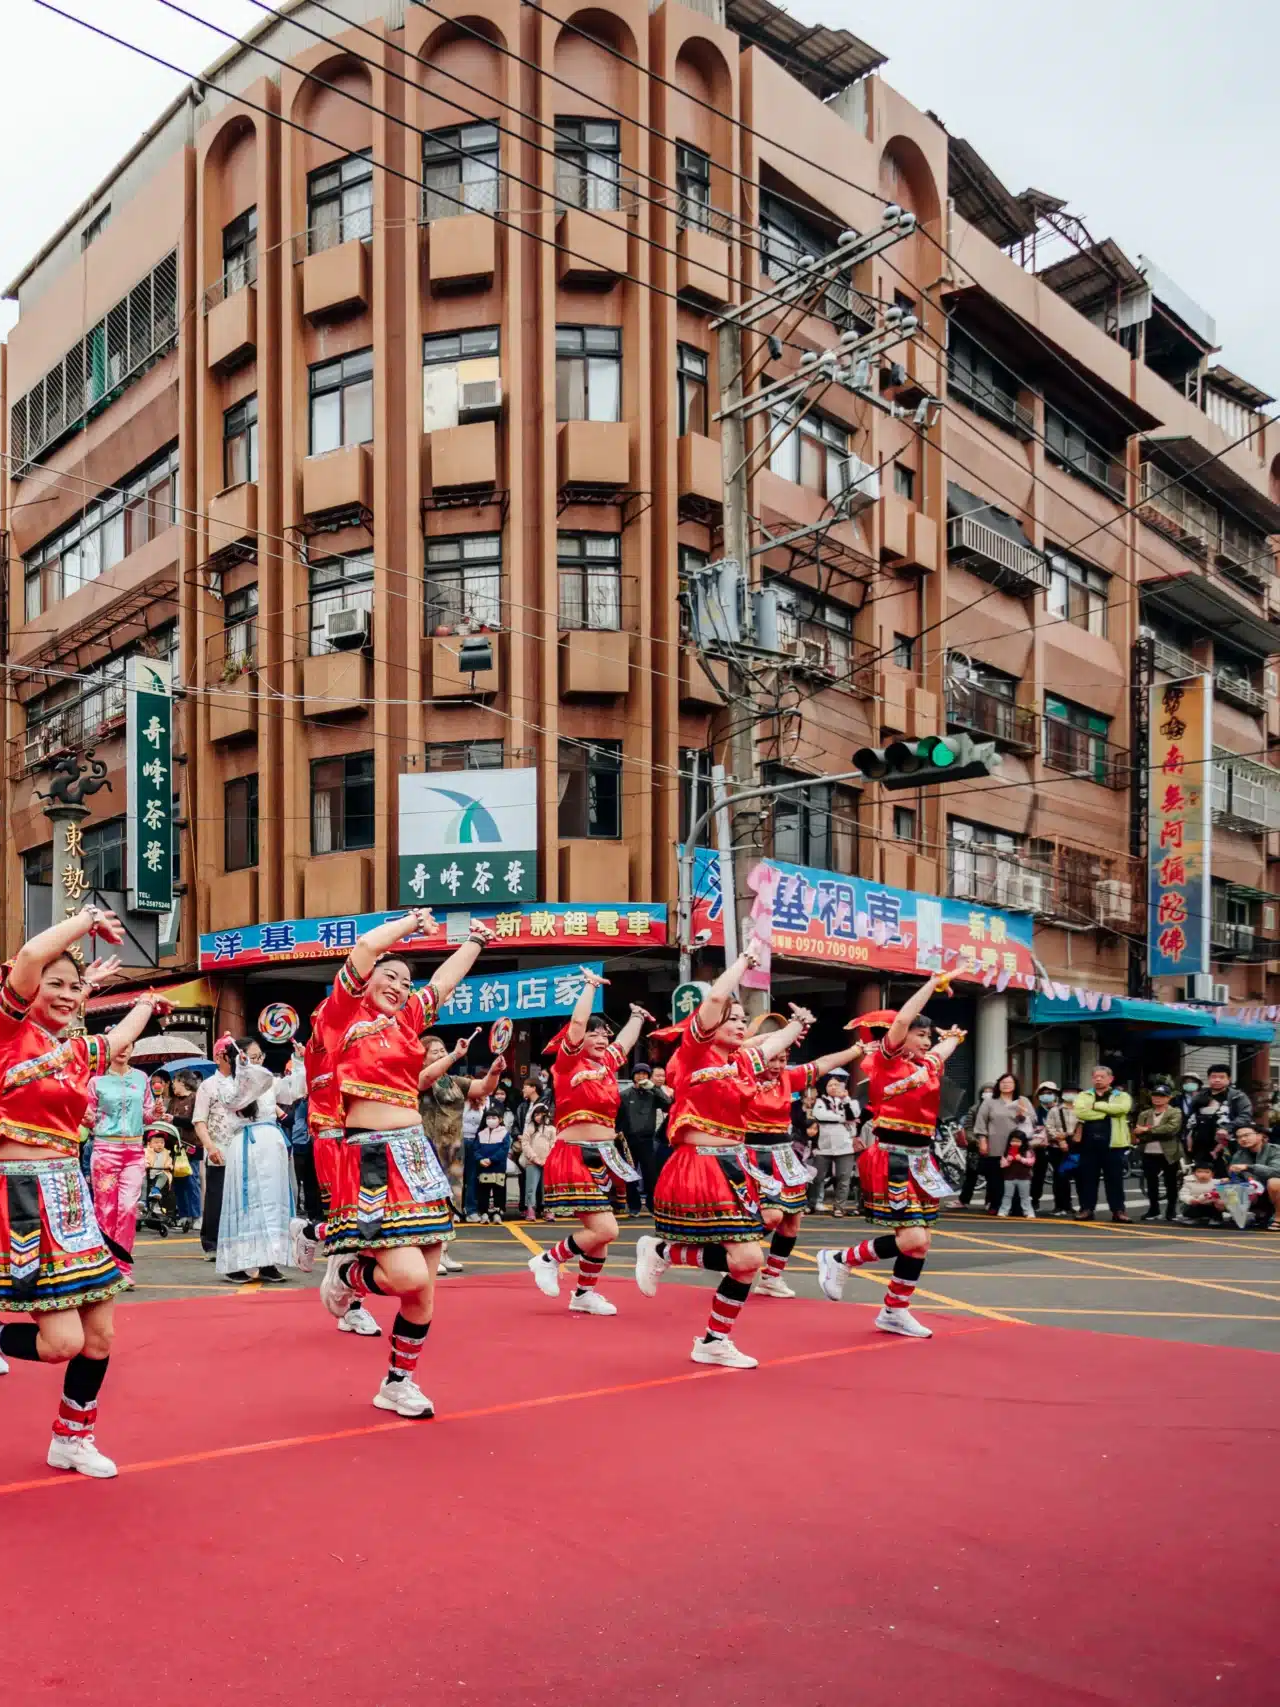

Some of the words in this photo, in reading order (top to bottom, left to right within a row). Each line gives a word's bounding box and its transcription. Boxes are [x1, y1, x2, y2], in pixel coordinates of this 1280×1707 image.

[142, 716, 167, 872] 奇峰茶葉
[408, 860, 525, 899] 奇峰茶葉
[214, 914, 425, 961] 洋基租
[495, 910, 651, 937] 新款鋰電車
[293, 951, 315, 960] 0970
[318, 949, 335, 957] 709
[795, 936, 824, 954] 0970
[826, 941, 846, 957] 709
[848, 945, 868, 961] 090
